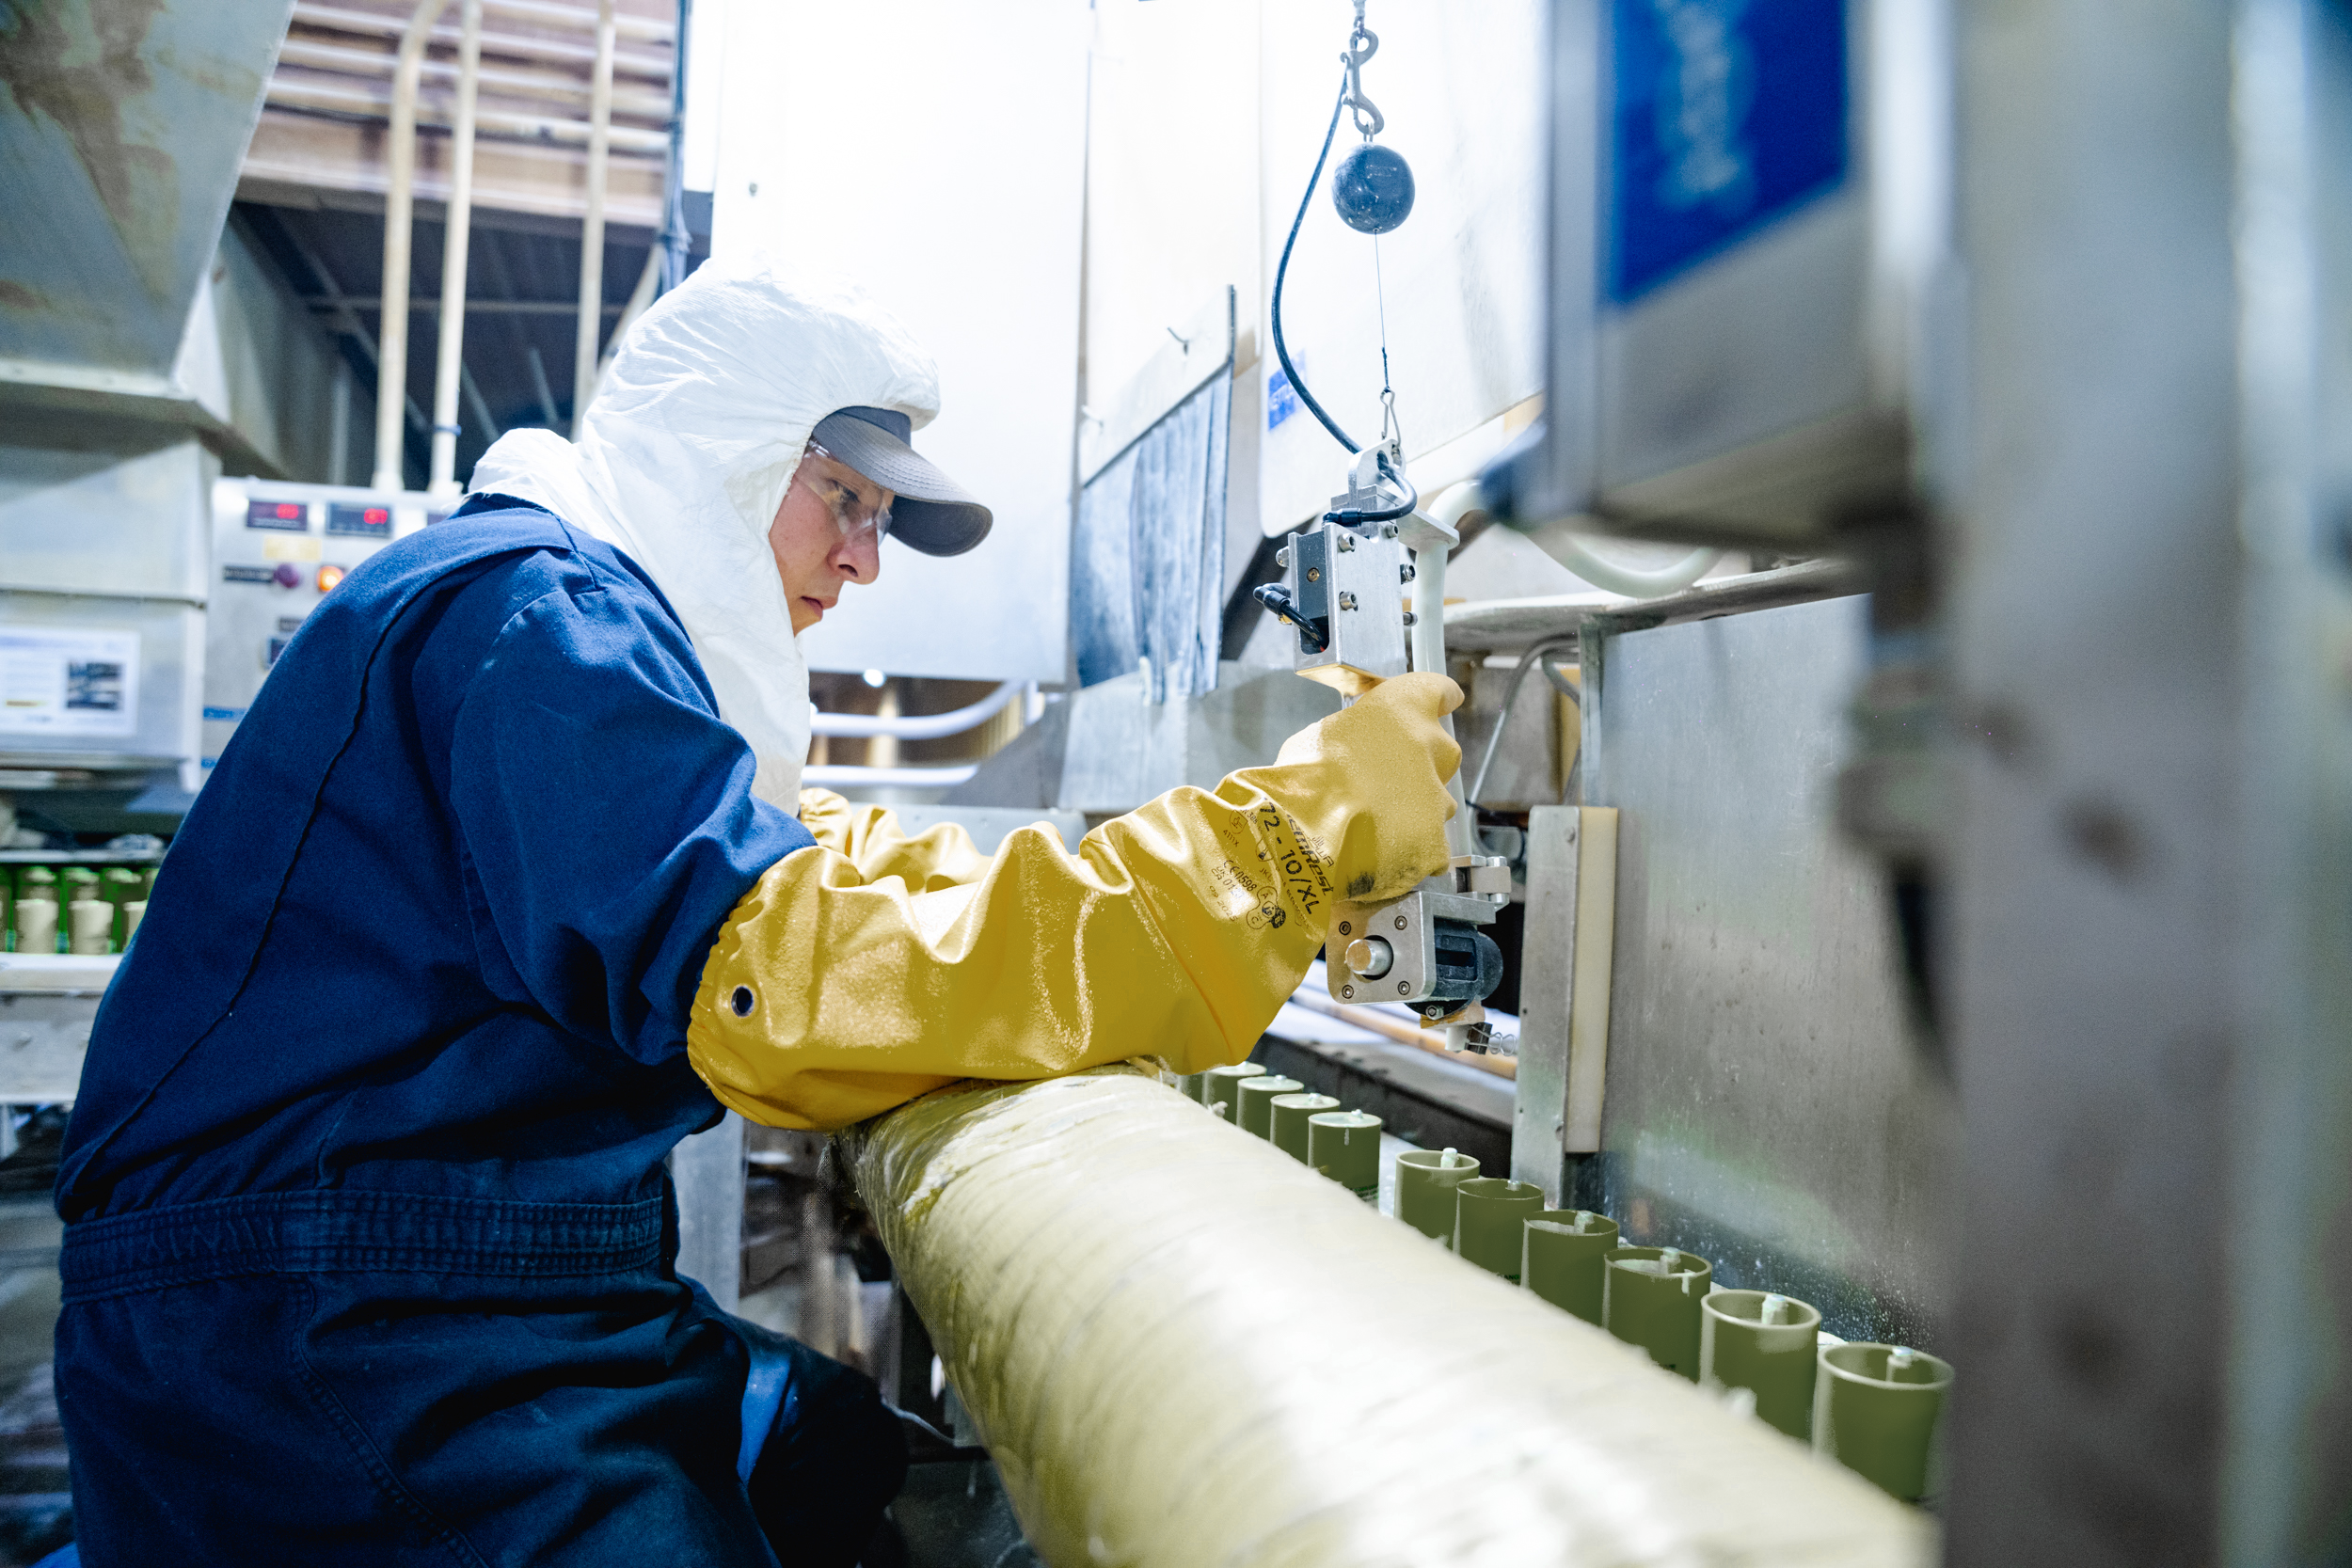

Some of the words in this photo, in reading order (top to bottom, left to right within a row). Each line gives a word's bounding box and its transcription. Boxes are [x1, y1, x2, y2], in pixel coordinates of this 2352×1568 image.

[1259, 867, 1273, 882] JKL
[1280, 849, 1320, 914] 10/XL
[1251, 916, 1260, 925] C
